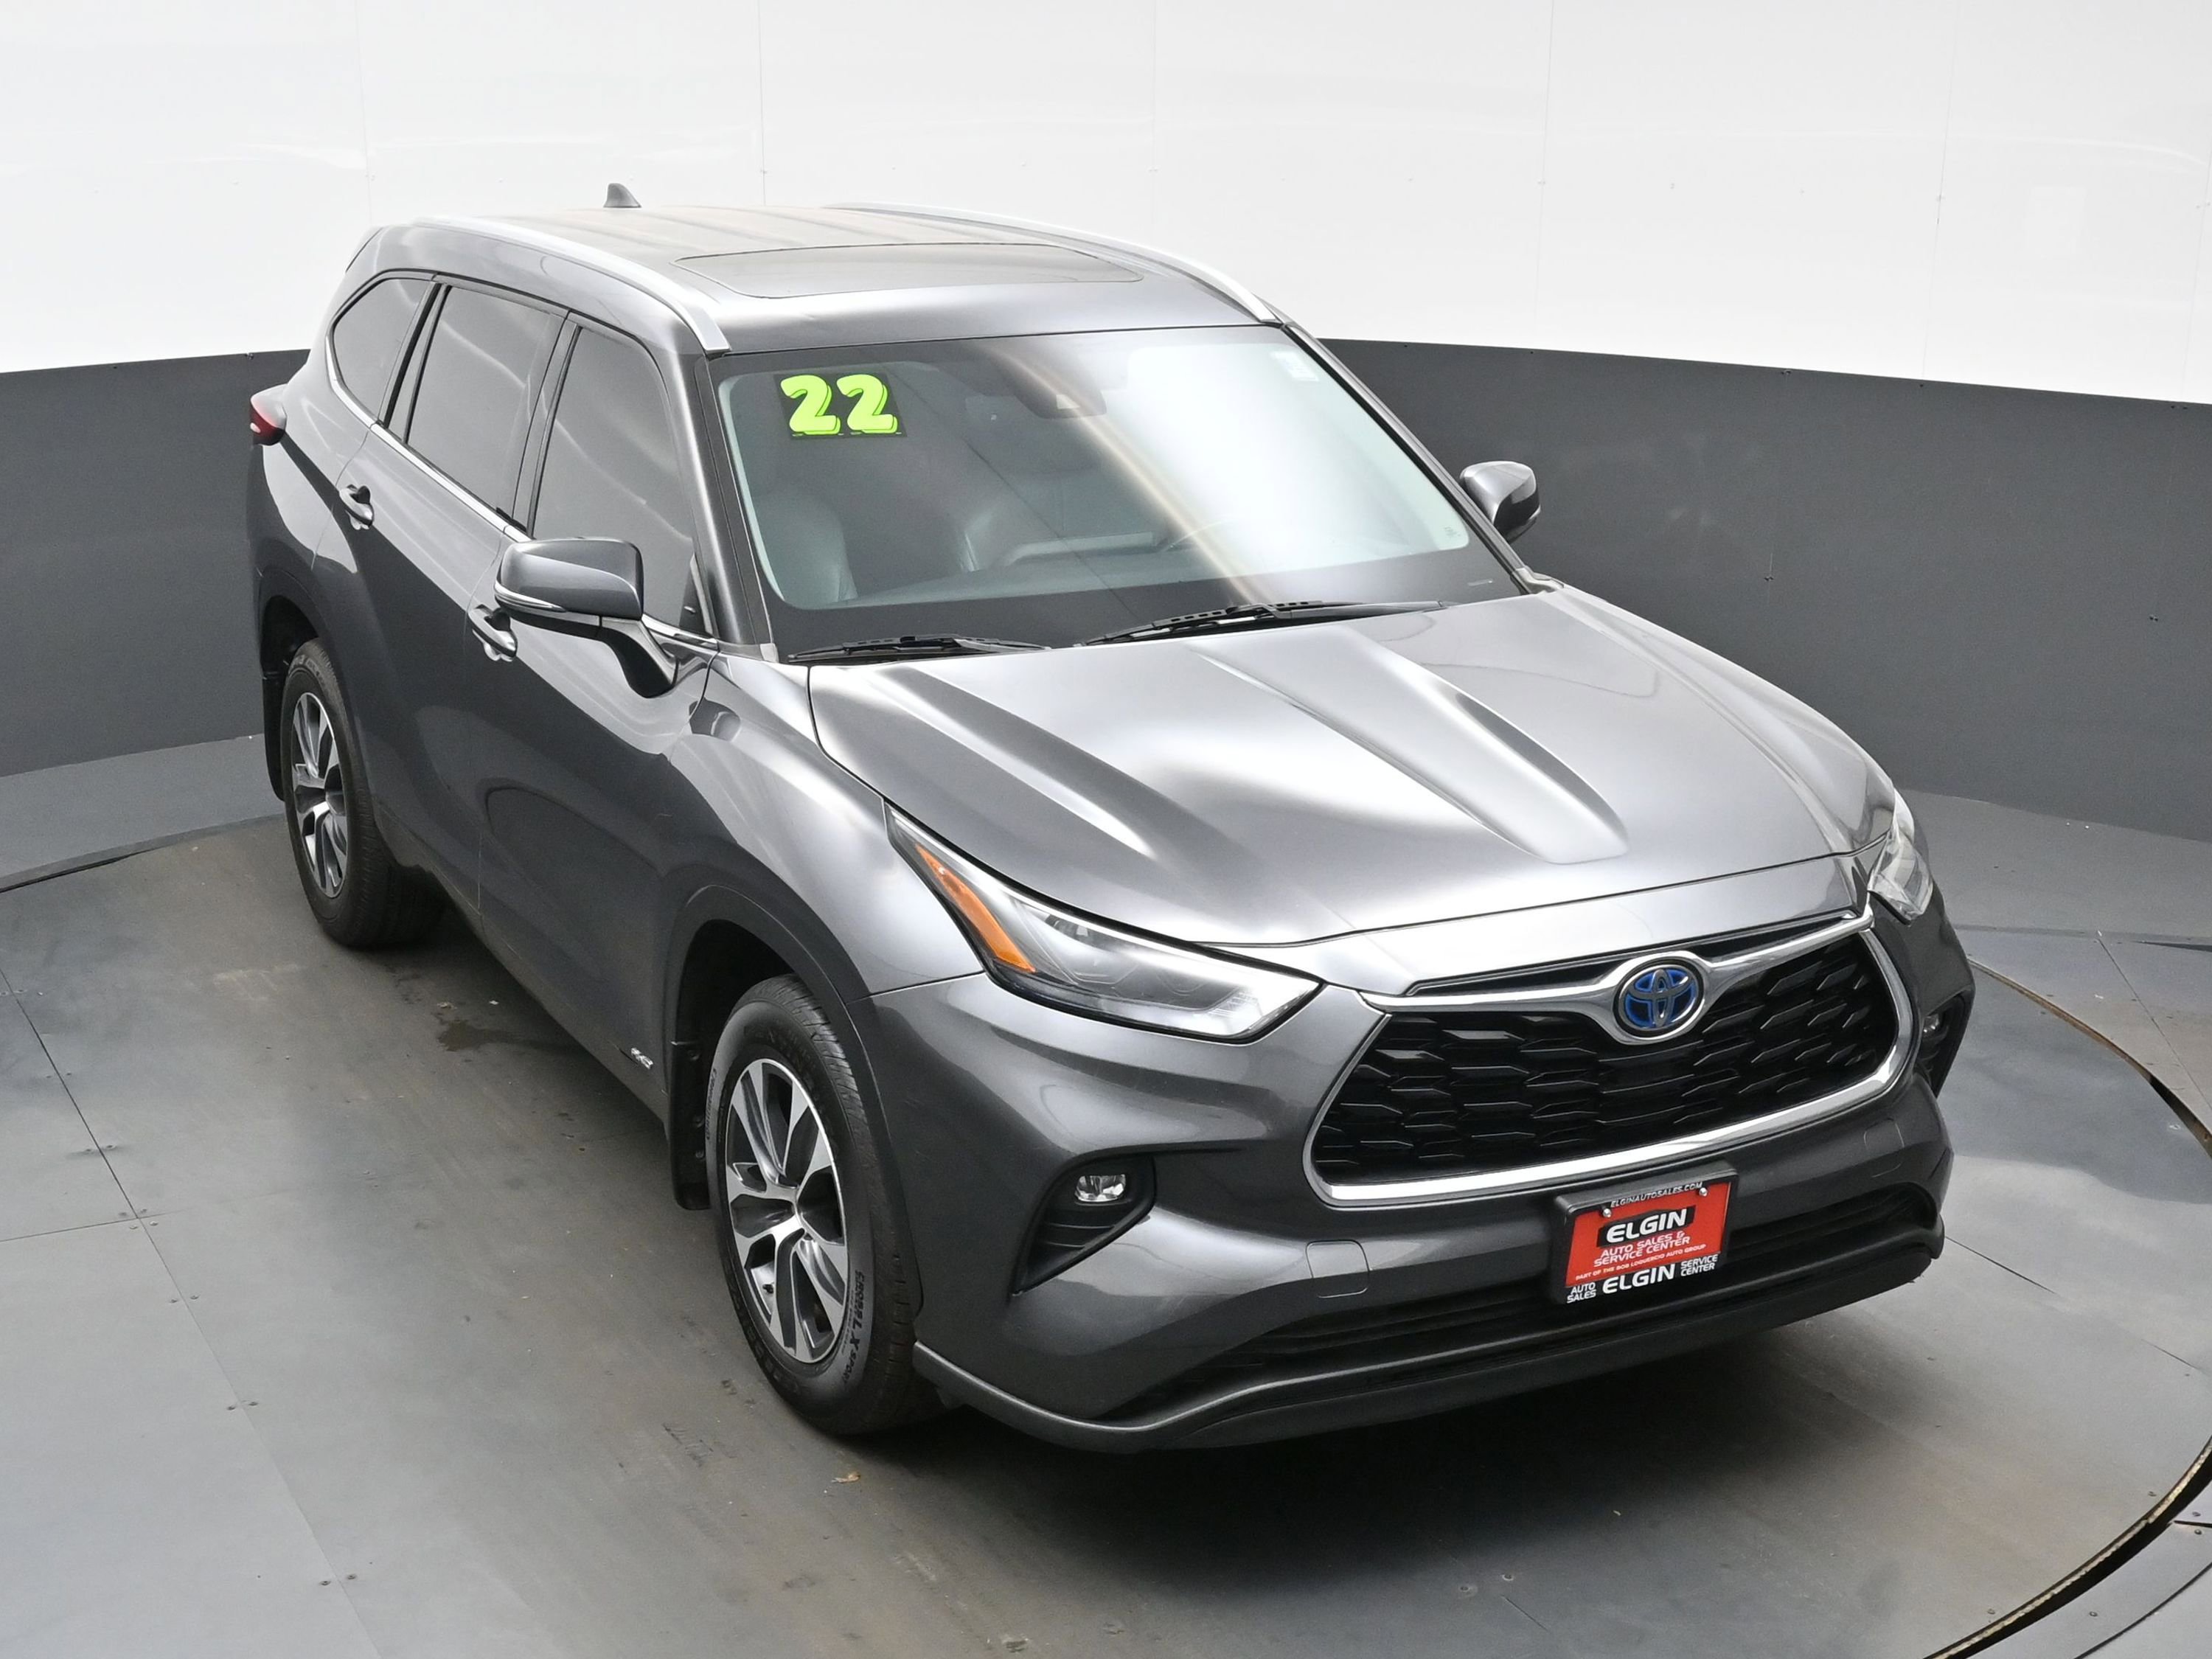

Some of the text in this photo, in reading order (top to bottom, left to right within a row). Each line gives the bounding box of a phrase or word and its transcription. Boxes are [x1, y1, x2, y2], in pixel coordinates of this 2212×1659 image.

[780, 374, 898, 435] 22
[1610, 1182, 1703, 1208] ELGINAUTOSALES.COM
[1606, 1208, 1687, 1243] ELGIN
[1593, 1236, 1691, 1267] SERVICE CENTER
[1600, 1231, 1686, 1259] AUTO SALES &
[1576, 1271, 1593, 1281] PART
[1666, 1249, 1683, 1258] AUTO
[1684, 1243, 1706, 1253] GROUP
[1681, 1253, 1719, 1270] SERVICE
[1681, 1262, 1716, 1277] CENTER
[1571, 1281, 1596, 1295] AUTO
[1602, 1263, 1675, 1294] ELGIN
[1567, 1289, 1597, 1304] SALES
